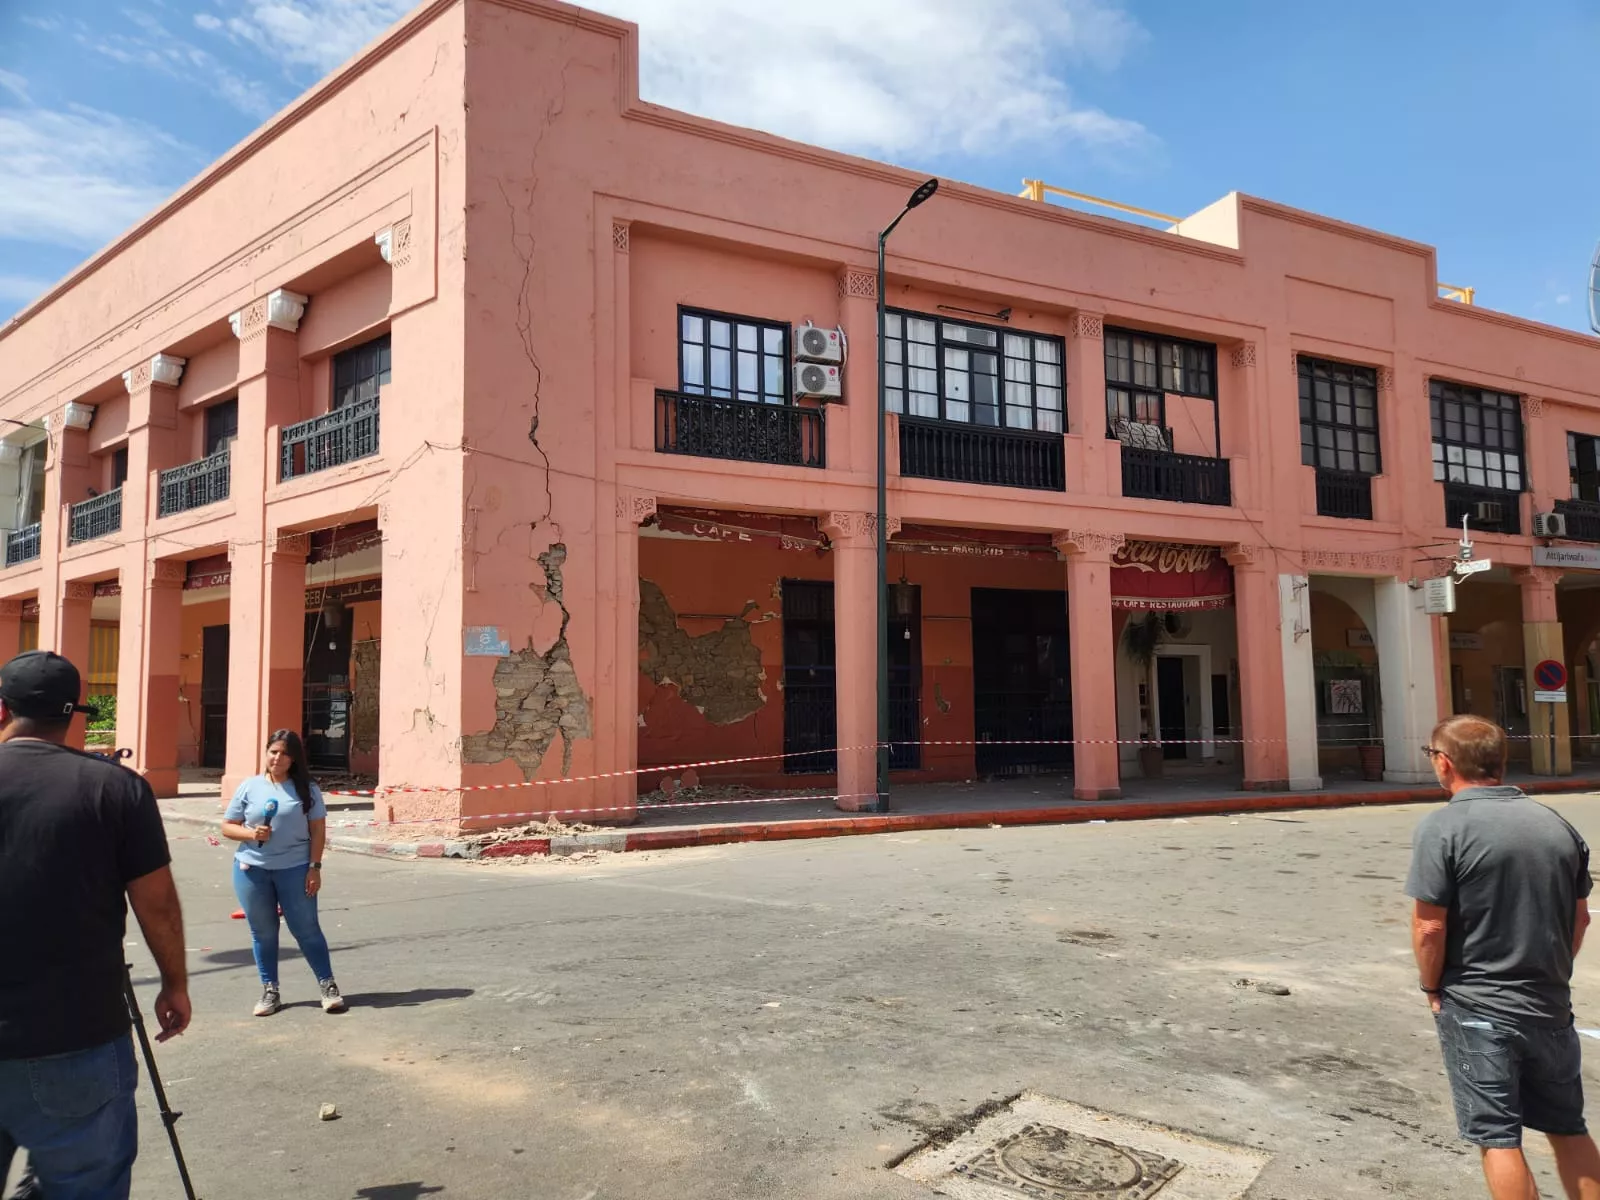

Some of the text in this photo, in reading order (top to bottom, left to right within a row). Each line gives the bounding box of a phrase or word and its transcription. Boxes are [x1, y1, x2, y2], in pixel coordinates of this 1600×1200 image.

[693, 523, 752, 542] CAFE
[211, 574, 230, 585] CAF
[1123, 600, 1145, 608] CAFE
[1149, 600, 1204, 608] RESTAURANT
